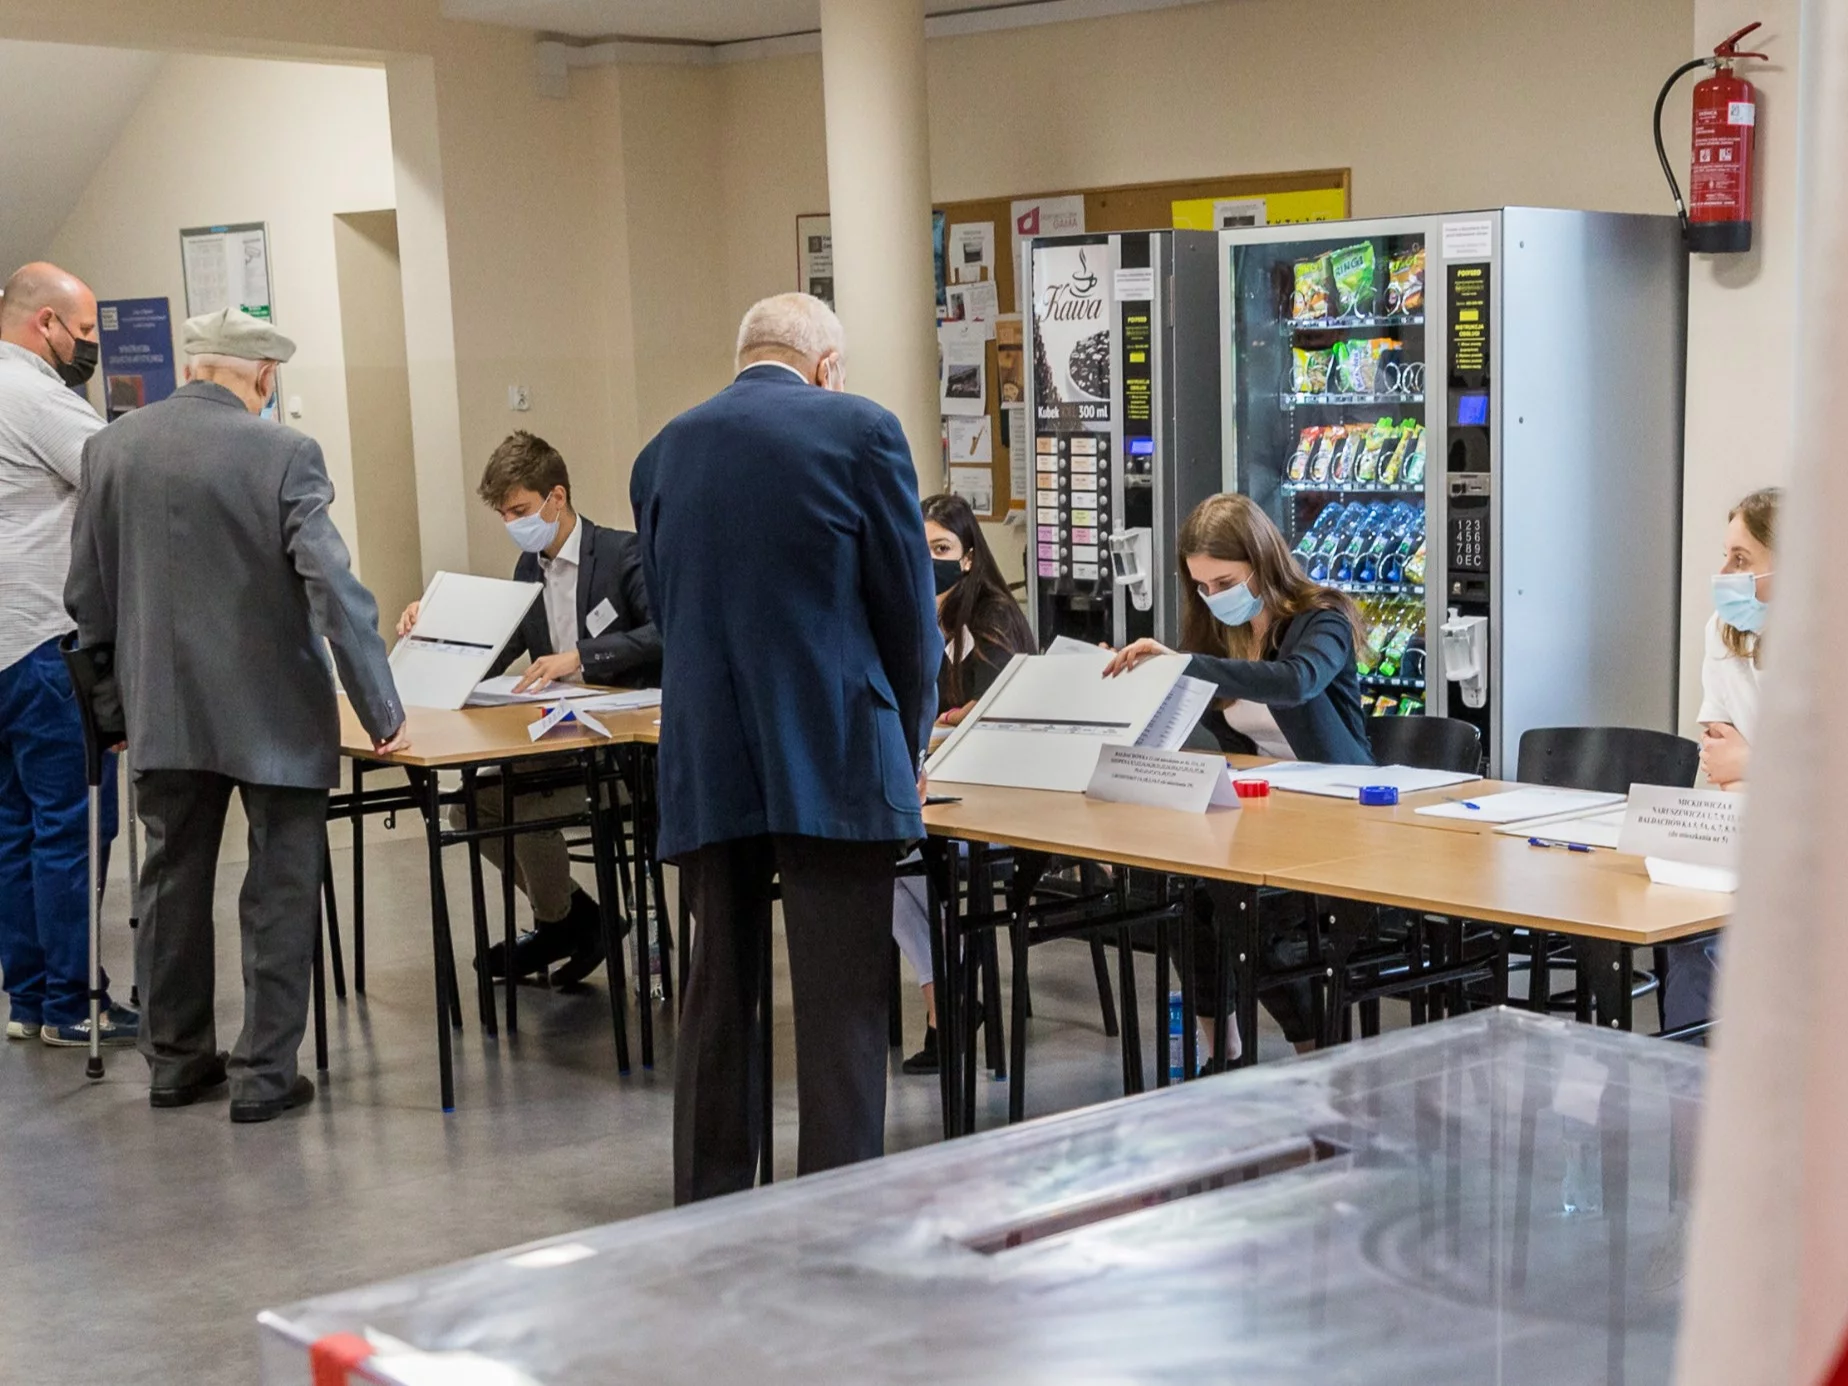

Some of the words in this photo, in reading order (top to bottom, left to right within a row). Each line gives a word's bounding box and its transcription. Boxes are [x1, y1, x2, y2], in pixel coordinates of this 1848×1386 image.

[1041, 283, 1103, 322] Kawa
[1038, 406, 1059, 419] Kubek
[1078, 405, 1095, 418] 300
[1096, 405, 1108, 418] ml
[1458, 519, 1463, 530] 1
[1465, 519, 1472, 531] 2
[1474, 519, 1481, 531] 3
[1456, 531, 1463, 542] 4
[1465, 531, 1472, 542] 5
[1474, 531, 1481, 542] 6
[1456, 542, 1463, 554] 7
[1465, 543, 1472, 554] 8
[1474, 543, 1481, 554] 9
[1465, 554, 1472, 566] E
[1473, 554, 1481, 566] C
[1678, 798, 1726, 810] MICKIEWICZA
